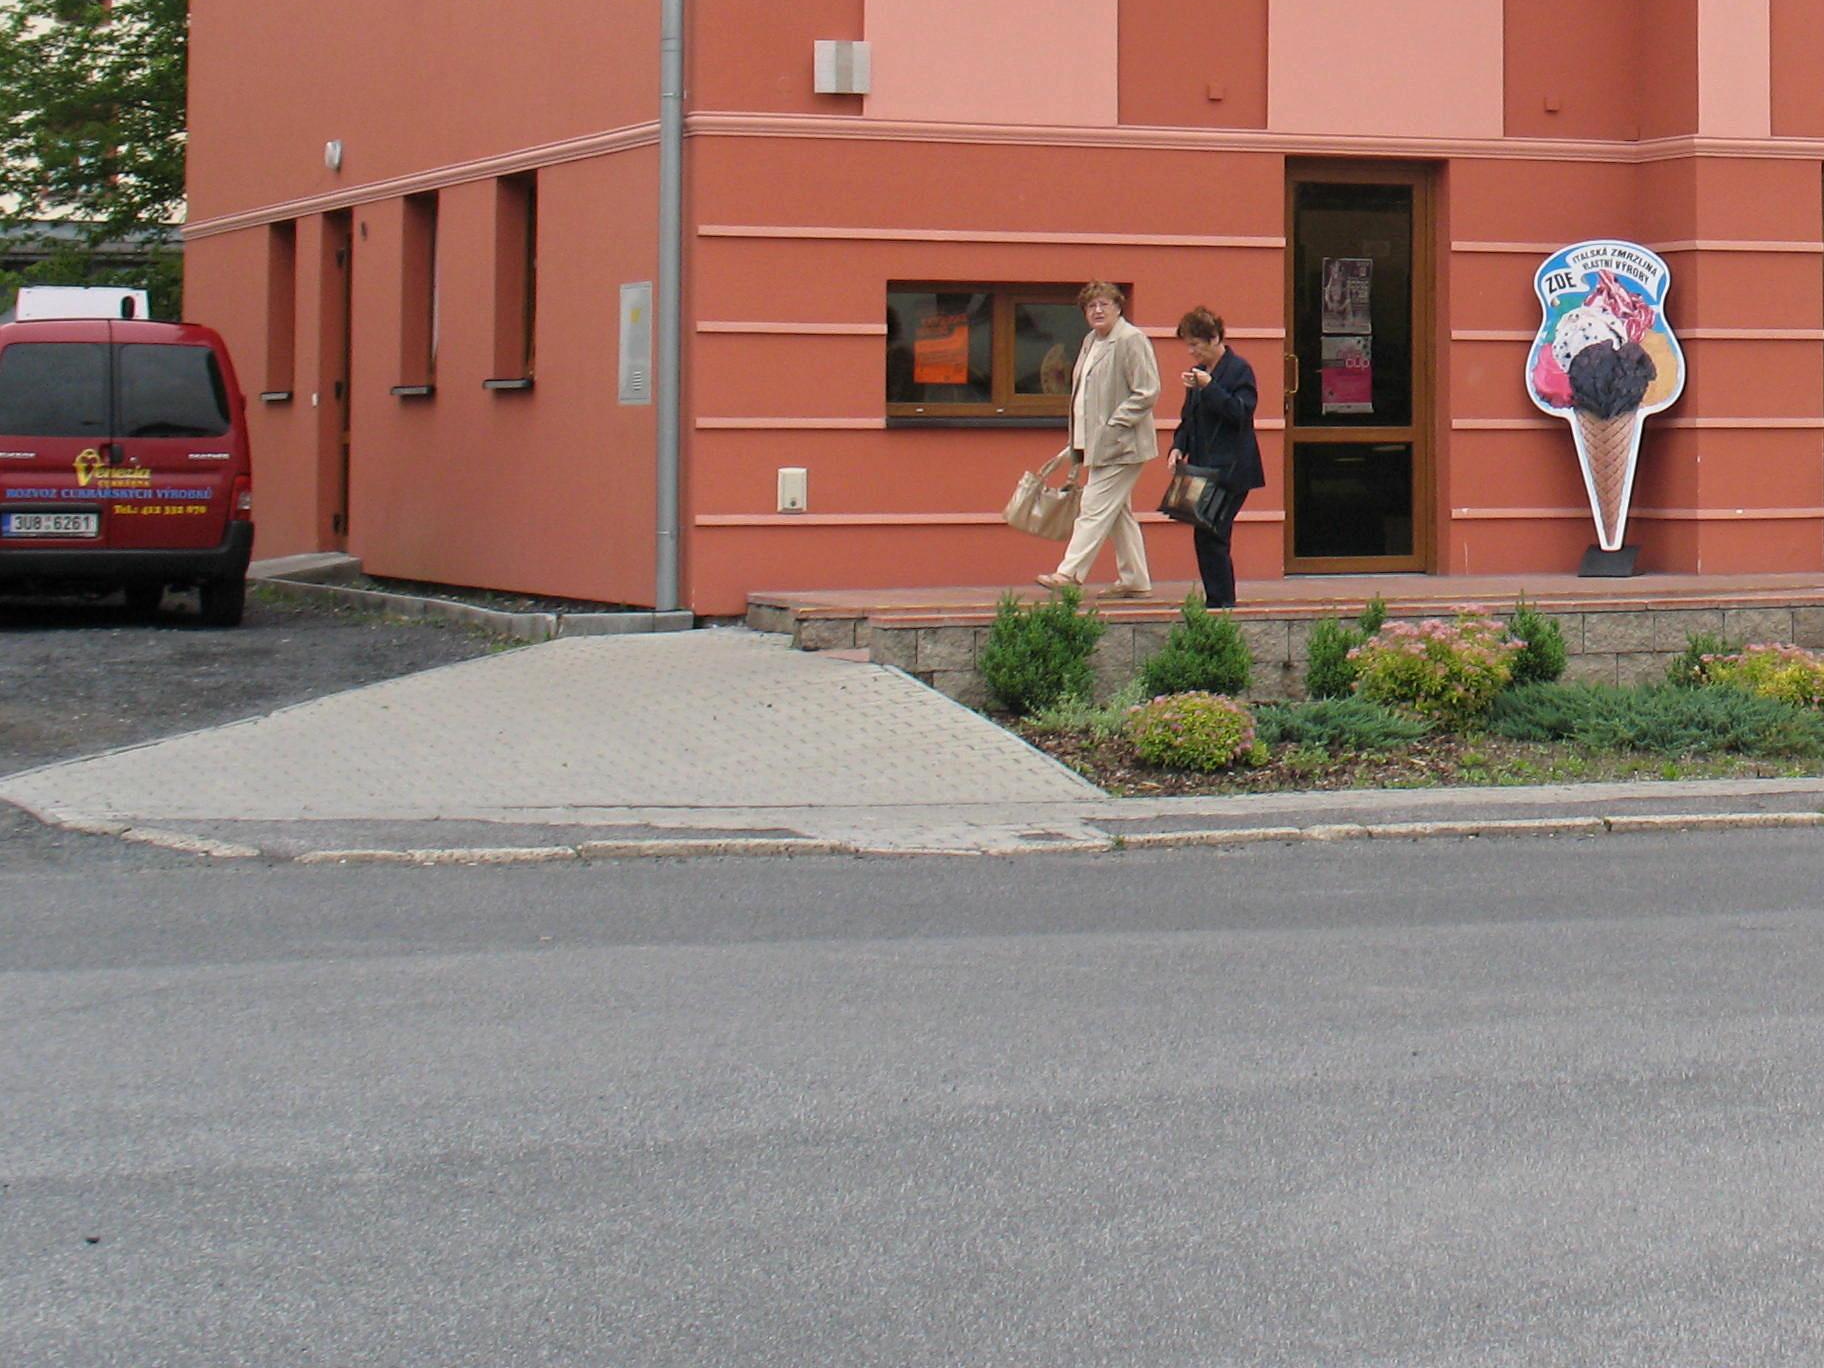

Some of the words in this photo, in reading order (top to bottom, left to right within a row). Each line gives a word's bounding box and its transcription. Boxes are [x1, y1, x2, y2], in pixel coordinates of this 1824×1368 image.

[1572, 246, 1608, 264] ITALSKÁ
[1610, 248, 1658, 277] ZMRZLINA
[1582, 258, 1613, 271] VLASTNÍ
[1615, 260, 1650, 285] VÝROBY
[1545, 271, 1577, 294] ZDE
[14, 516, 41, 530] 3U8
[53, 516, 91, 530] 6261
